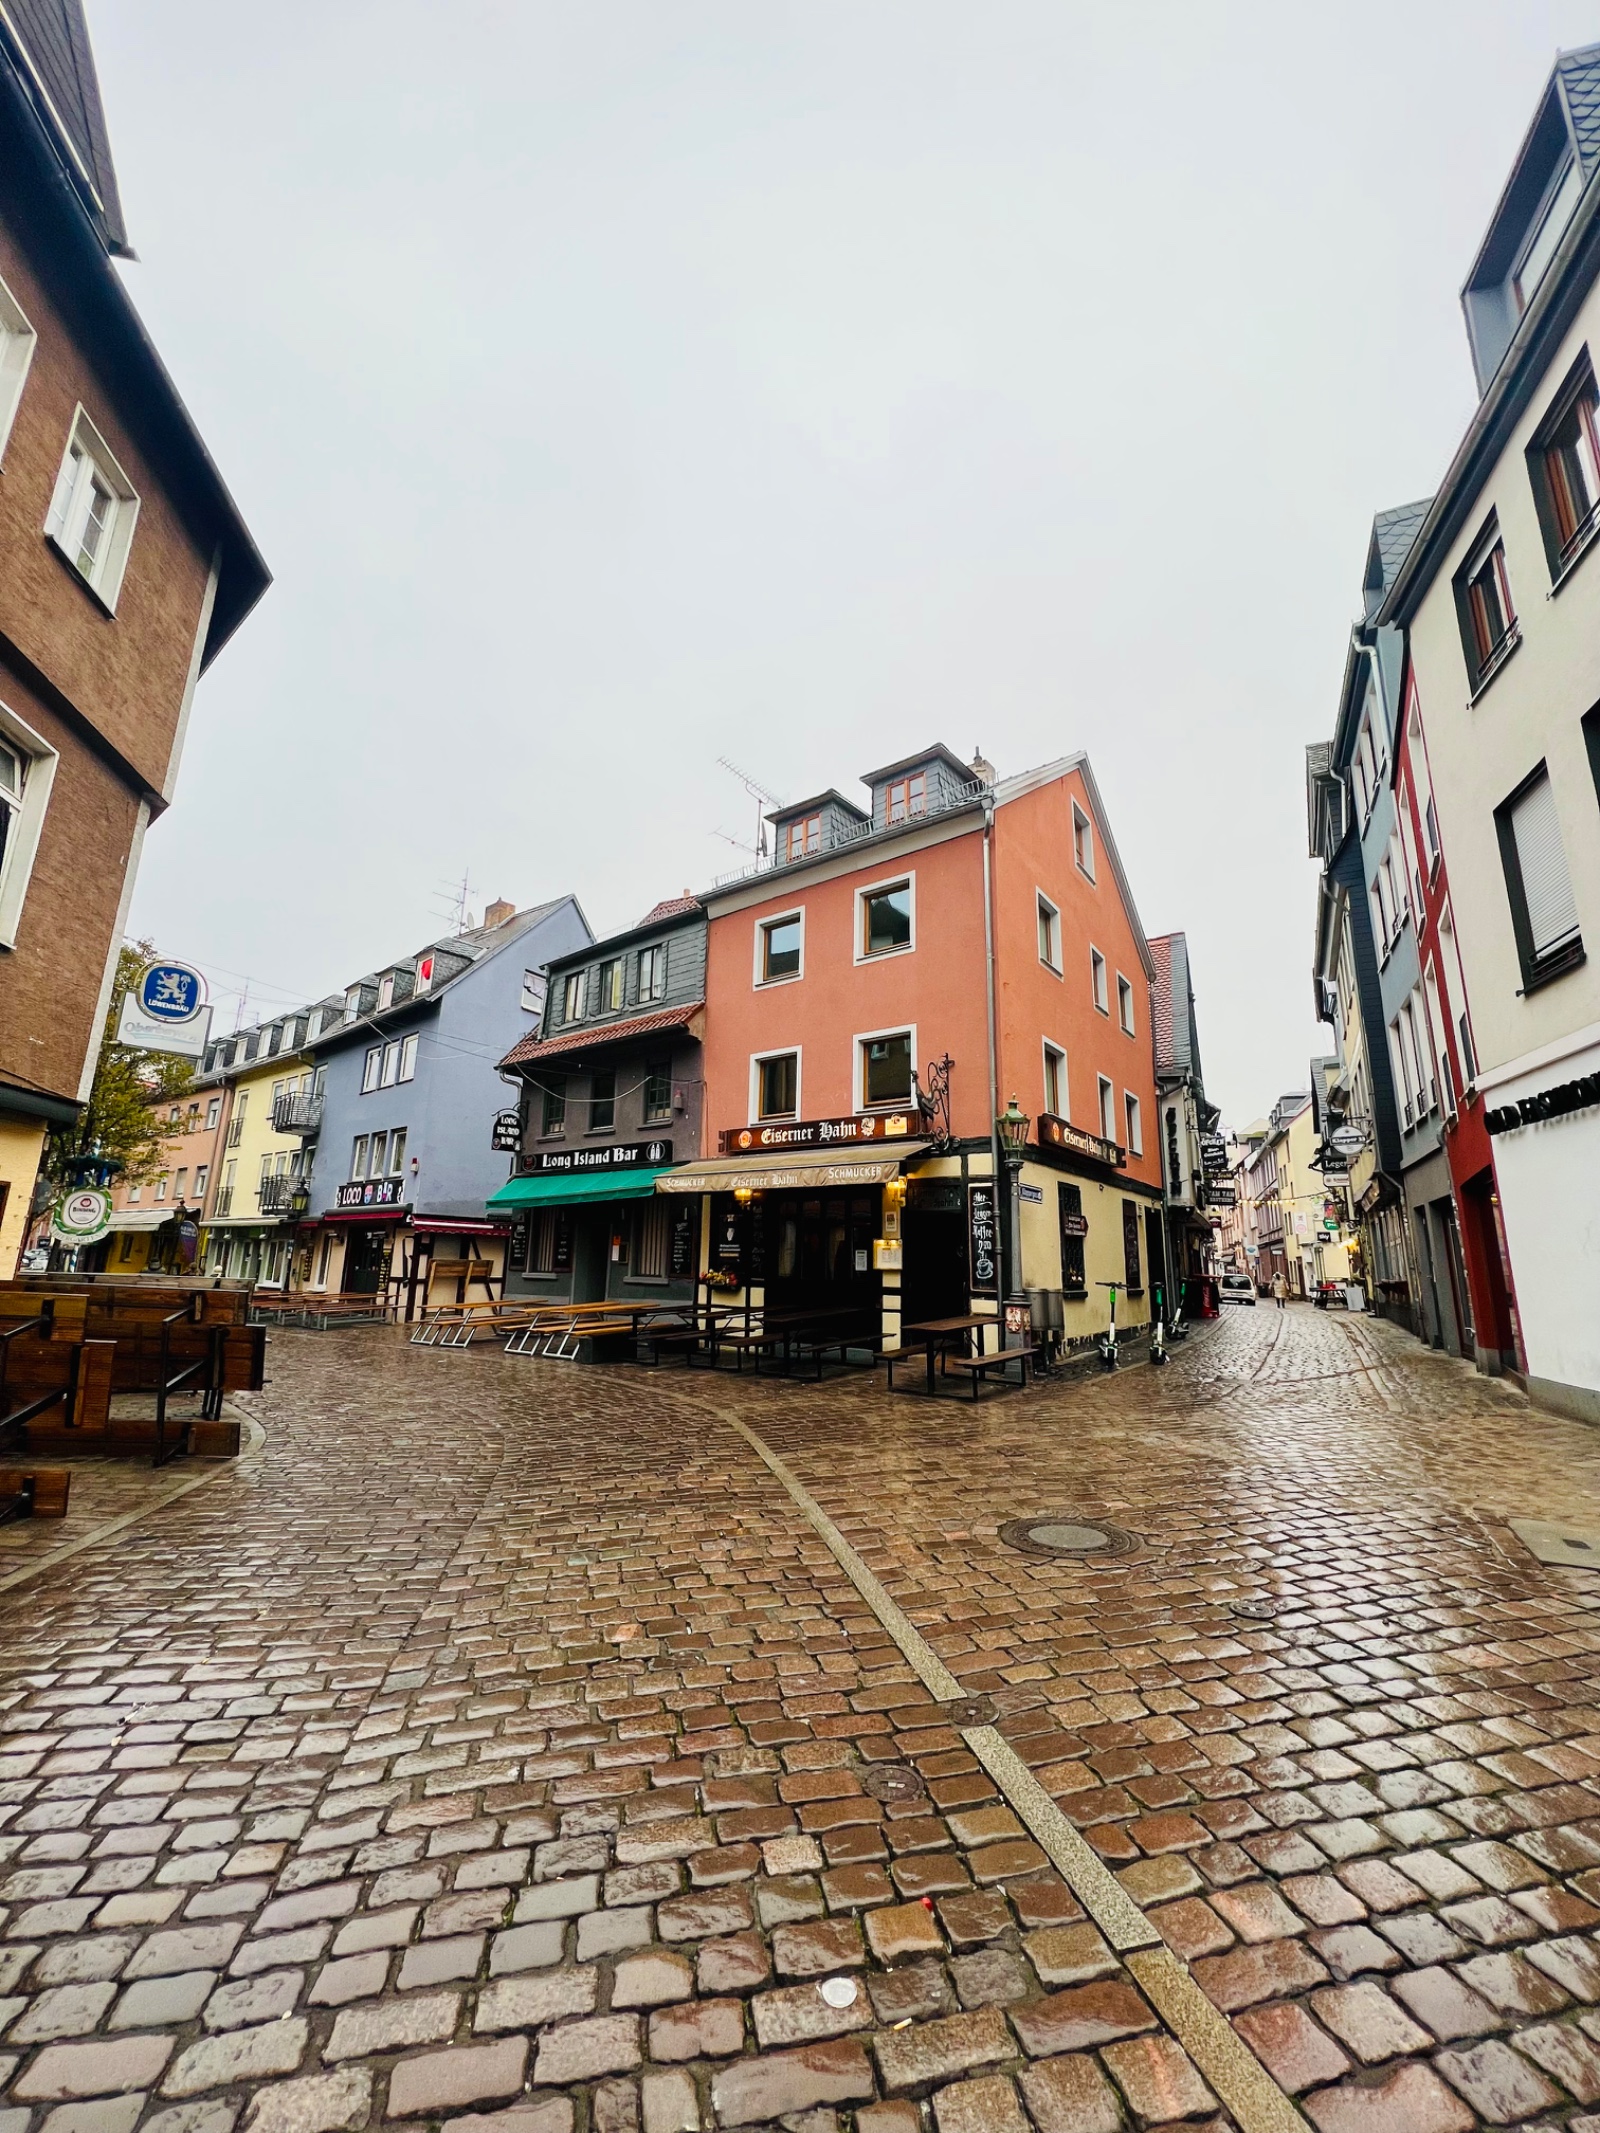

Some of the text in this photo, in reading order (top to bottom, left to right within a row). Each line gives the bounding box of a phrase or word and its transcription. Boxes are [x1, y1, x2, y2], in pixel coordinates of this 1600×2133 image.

[500, 1115, 518, 1126] LONG
[496, 1126, 520, 1136] ISLAND
[761, 1121, 857, 1145] Eiserner Hahn
[500, 1136, 515, 1146] BAR
[542, 1147, 638, 1169] Long Island Bar
[731, 1175, 767, 1188] Eiserner
[771, 1173, 798, 1186] Hahn
[828, 1165, 882, 1179] SCHMUCKER
[342, 1186, 362, 1205] LOCO
